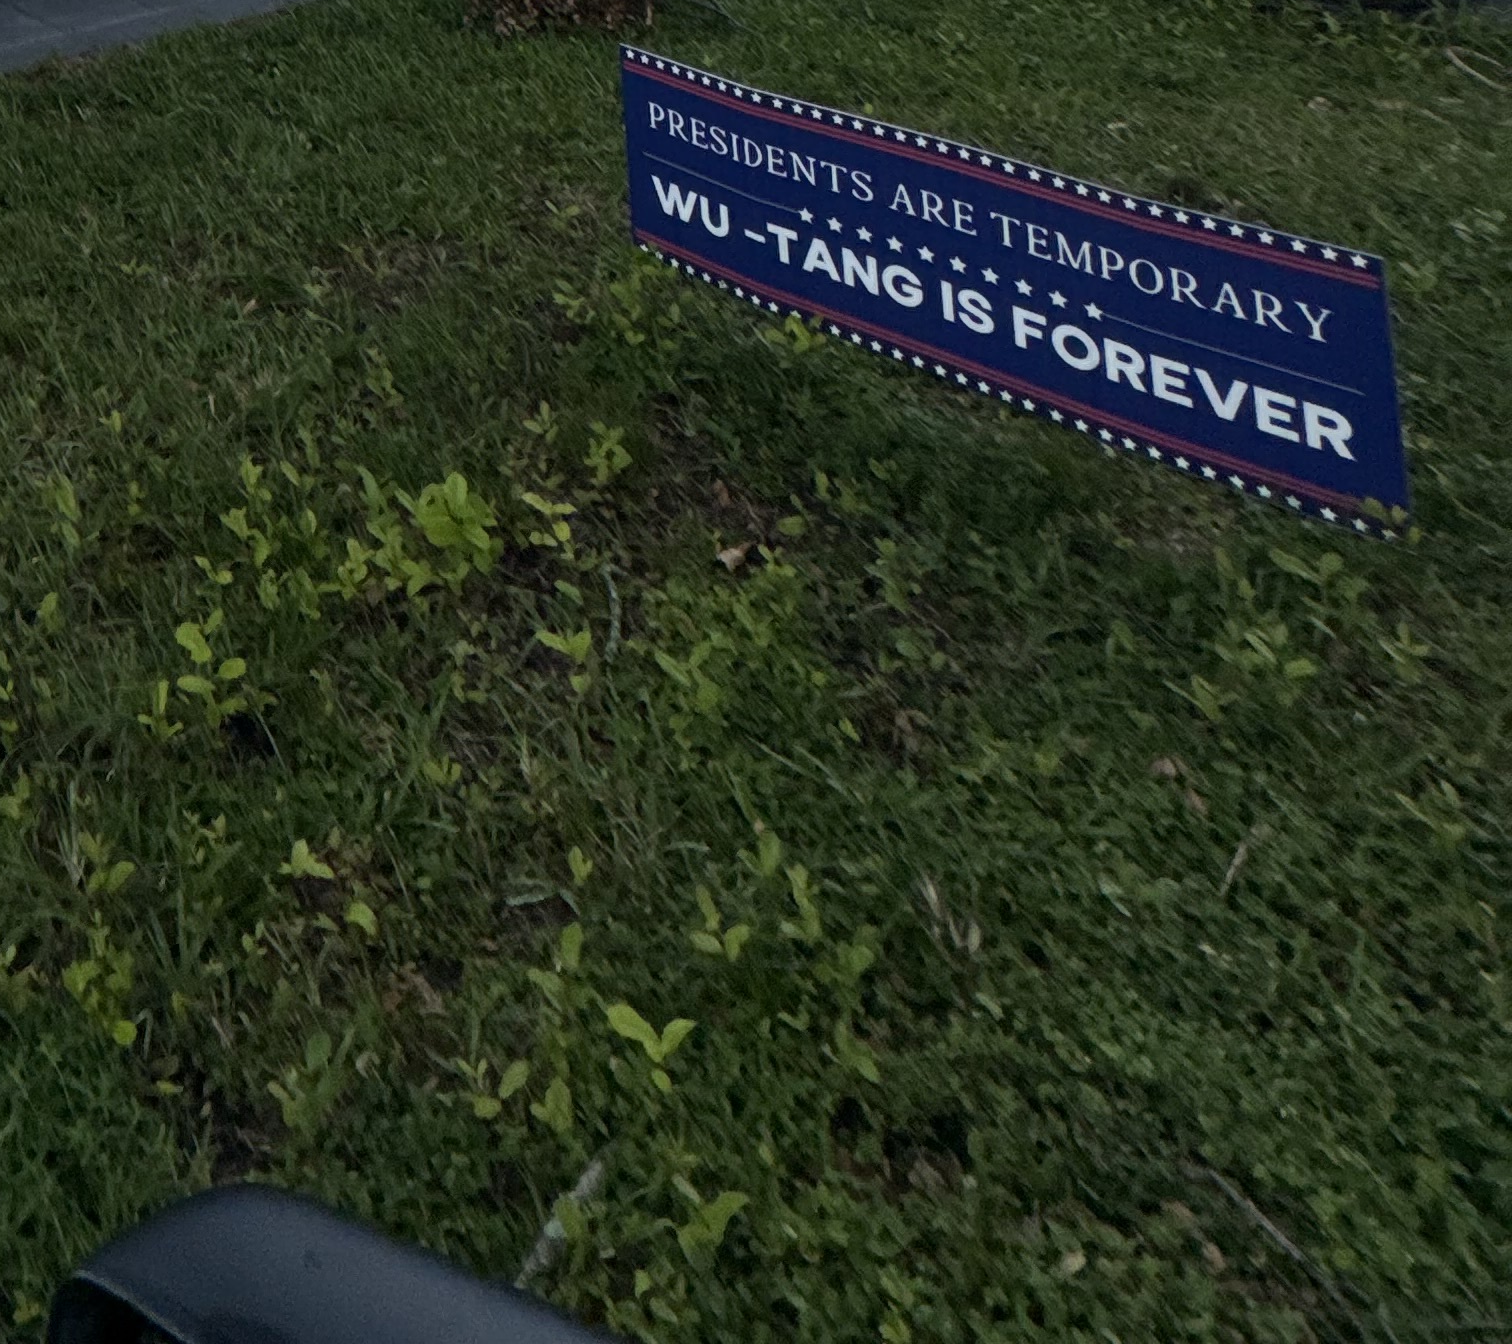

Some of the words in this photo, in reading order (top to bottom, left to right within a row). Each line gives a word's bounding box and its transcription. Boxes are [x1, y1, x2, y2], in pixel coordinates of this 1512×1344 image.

[647, 100, 875, 203] PRESIDENTS
[889, 182, 978, 237] ARE
[989, 212, 1334, 345] TEMPORARY
[940, 279, 994, 335] IS
[1012, 304, 1356, 462] FOREVER
